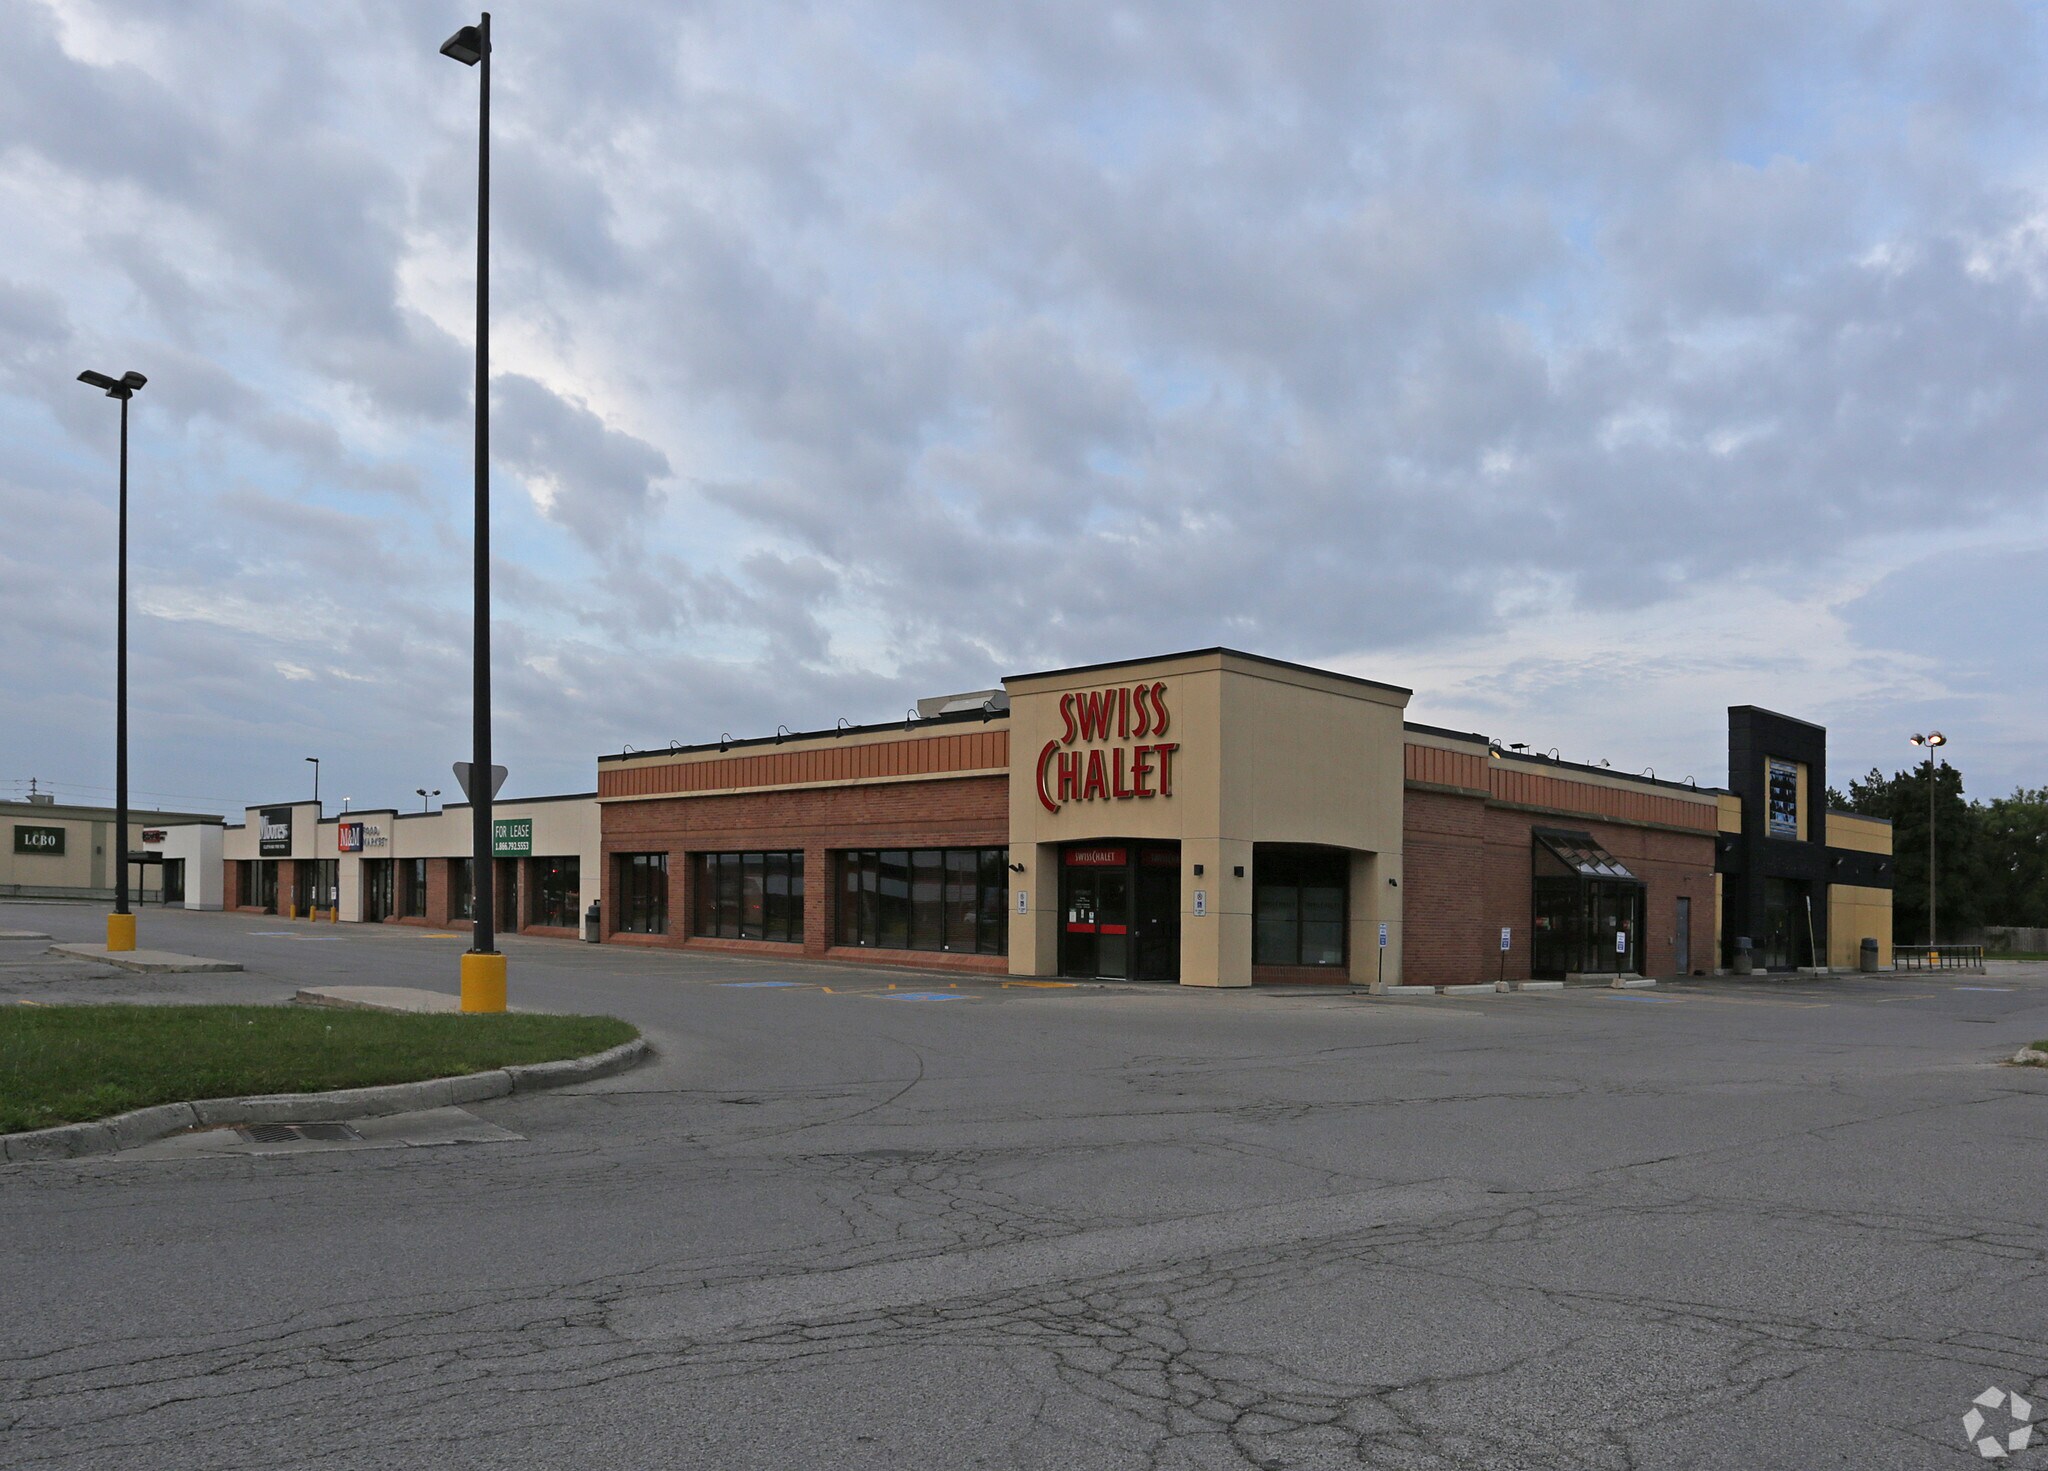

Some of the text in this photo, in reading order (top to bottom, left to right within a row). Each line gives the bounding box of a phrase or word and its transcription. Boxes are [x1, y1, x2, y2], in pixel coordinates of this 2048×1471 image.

[1059, 681, 1170, 745] SWISS
[1036, 739, 1180, 814] CHALET
[24, 833, 56, 847] LCBO
[340, 827, 360, 847] M&M
[495, 824, 529, 838] FOR LEASE
